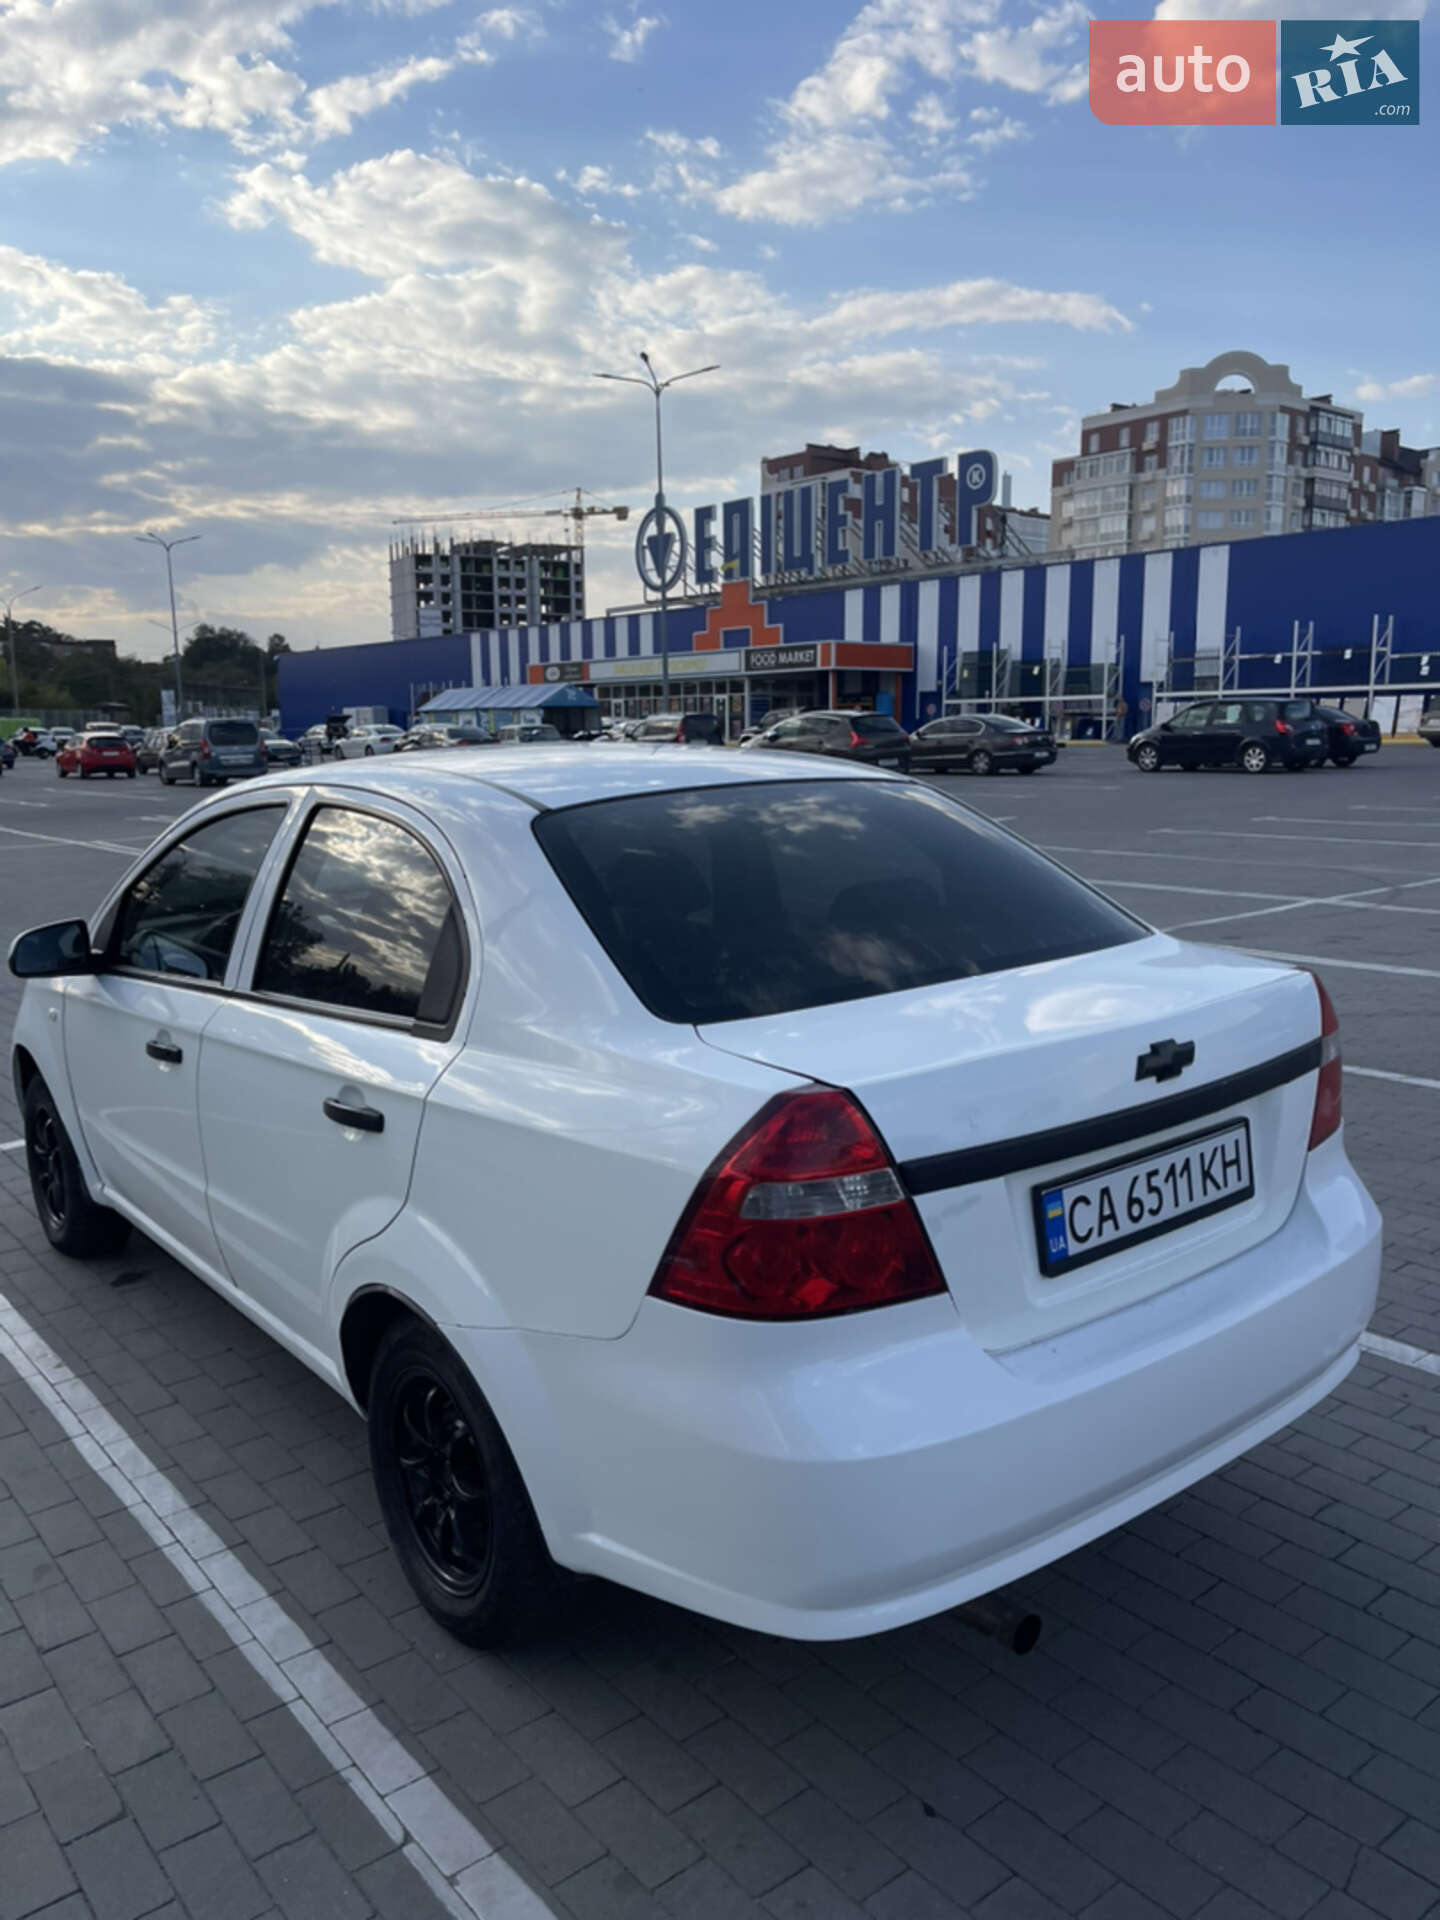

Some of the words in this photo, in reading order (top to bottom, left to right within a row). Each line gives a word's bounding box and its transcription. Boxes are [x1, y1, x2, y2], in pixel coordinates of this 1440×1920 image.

[750, 651, 777, 667] FOOD
[778, 649, 815, 664] MARKET
[1068, 1186, 1120, 1244] CA
[1127, 1156, 1194, 1224] 6511
[1199, 1138, 1243, 1197] KH
[1049, 1235, 1067, 1253] UA
